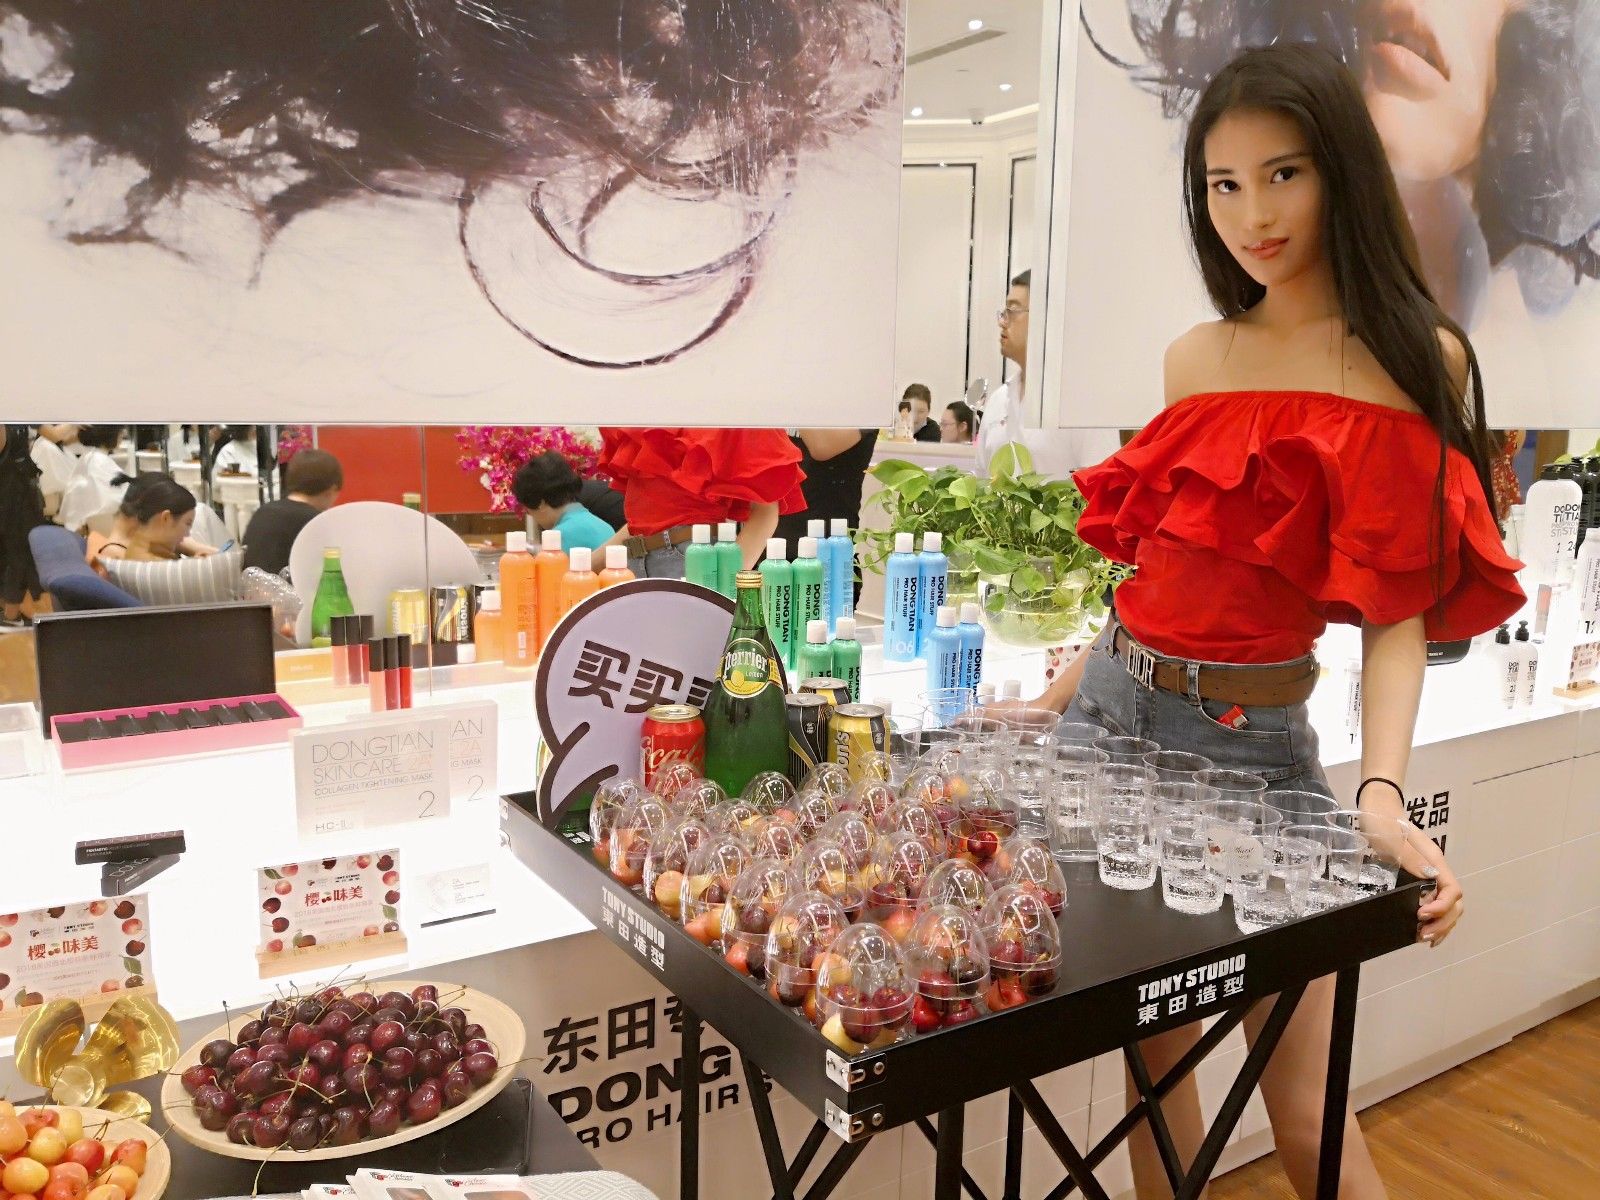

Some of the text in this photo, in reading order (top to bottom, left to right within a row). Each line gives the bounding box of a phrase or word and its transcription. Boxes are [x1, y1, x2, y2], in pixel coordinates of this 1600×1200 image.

[813, 583, 821, 617] DONG
[937, 575, 945, 606] DONG
[782, 585, 791, 643] DONG TIAN
[974, 648, 982, 680] DONG
[312, 731, 434, 764] DONGTIAN
[313, 758, 401, 785] SKINCARE
[314, 772, 434, 797] COLLAGEN TIGHTENING MASK
[467, 774, 484, 802] 2
[418, 790, 436, 819] 2
[602, 886, 665, 950] TONY STUDIO
[601, 905, 665, 972] 東田造型
[1138, 953, 1246, 1003] TONY STUDIO
[1136, 974, 1244, 1026] 東田造型
[576, 1083, 740, 1149] RO HIR
